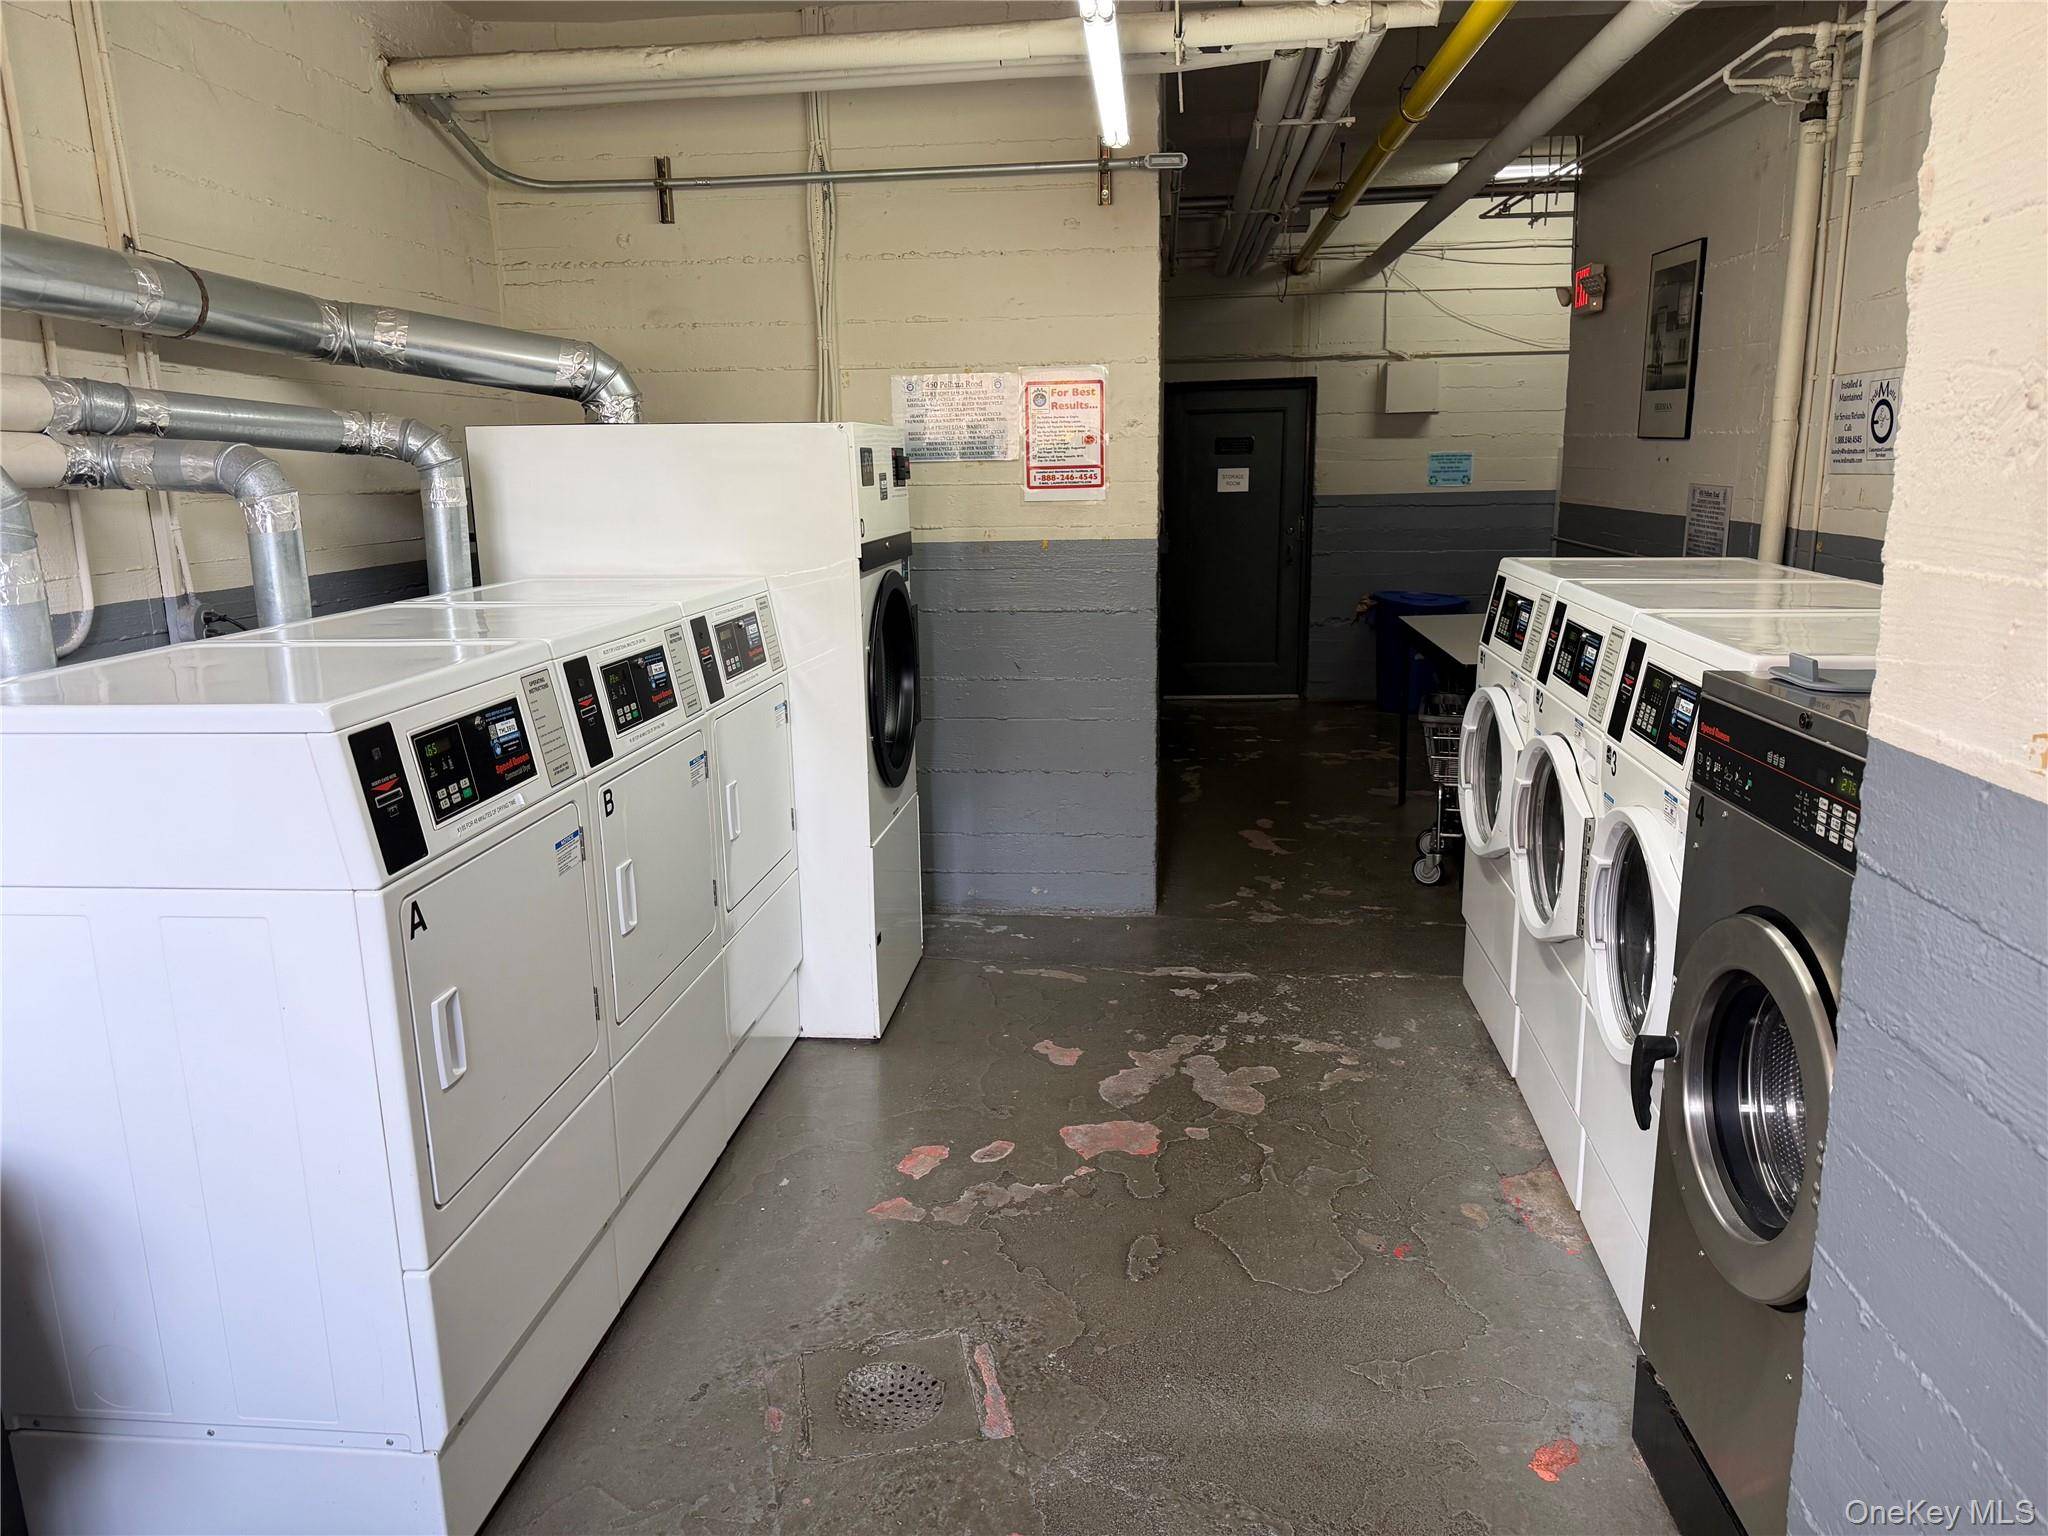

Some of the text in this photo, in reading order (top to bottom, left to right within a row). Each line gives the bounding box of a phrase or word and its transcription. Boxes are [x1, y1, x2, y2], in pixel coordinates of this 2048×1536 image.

[1051, 387, 1096, 397] For Best
[1051, 401, 1098, 410] Results...
[1033, 473, 1098, 482] 1-888-246-4545
[1701, 722, 1730, 743] Speed Queen
[496, 753, 529, 775] Speed Queen
[603, 788, 614, 818] B
[1695, 796, 1705, 827] 4
[410, 900, 428, 941] A
